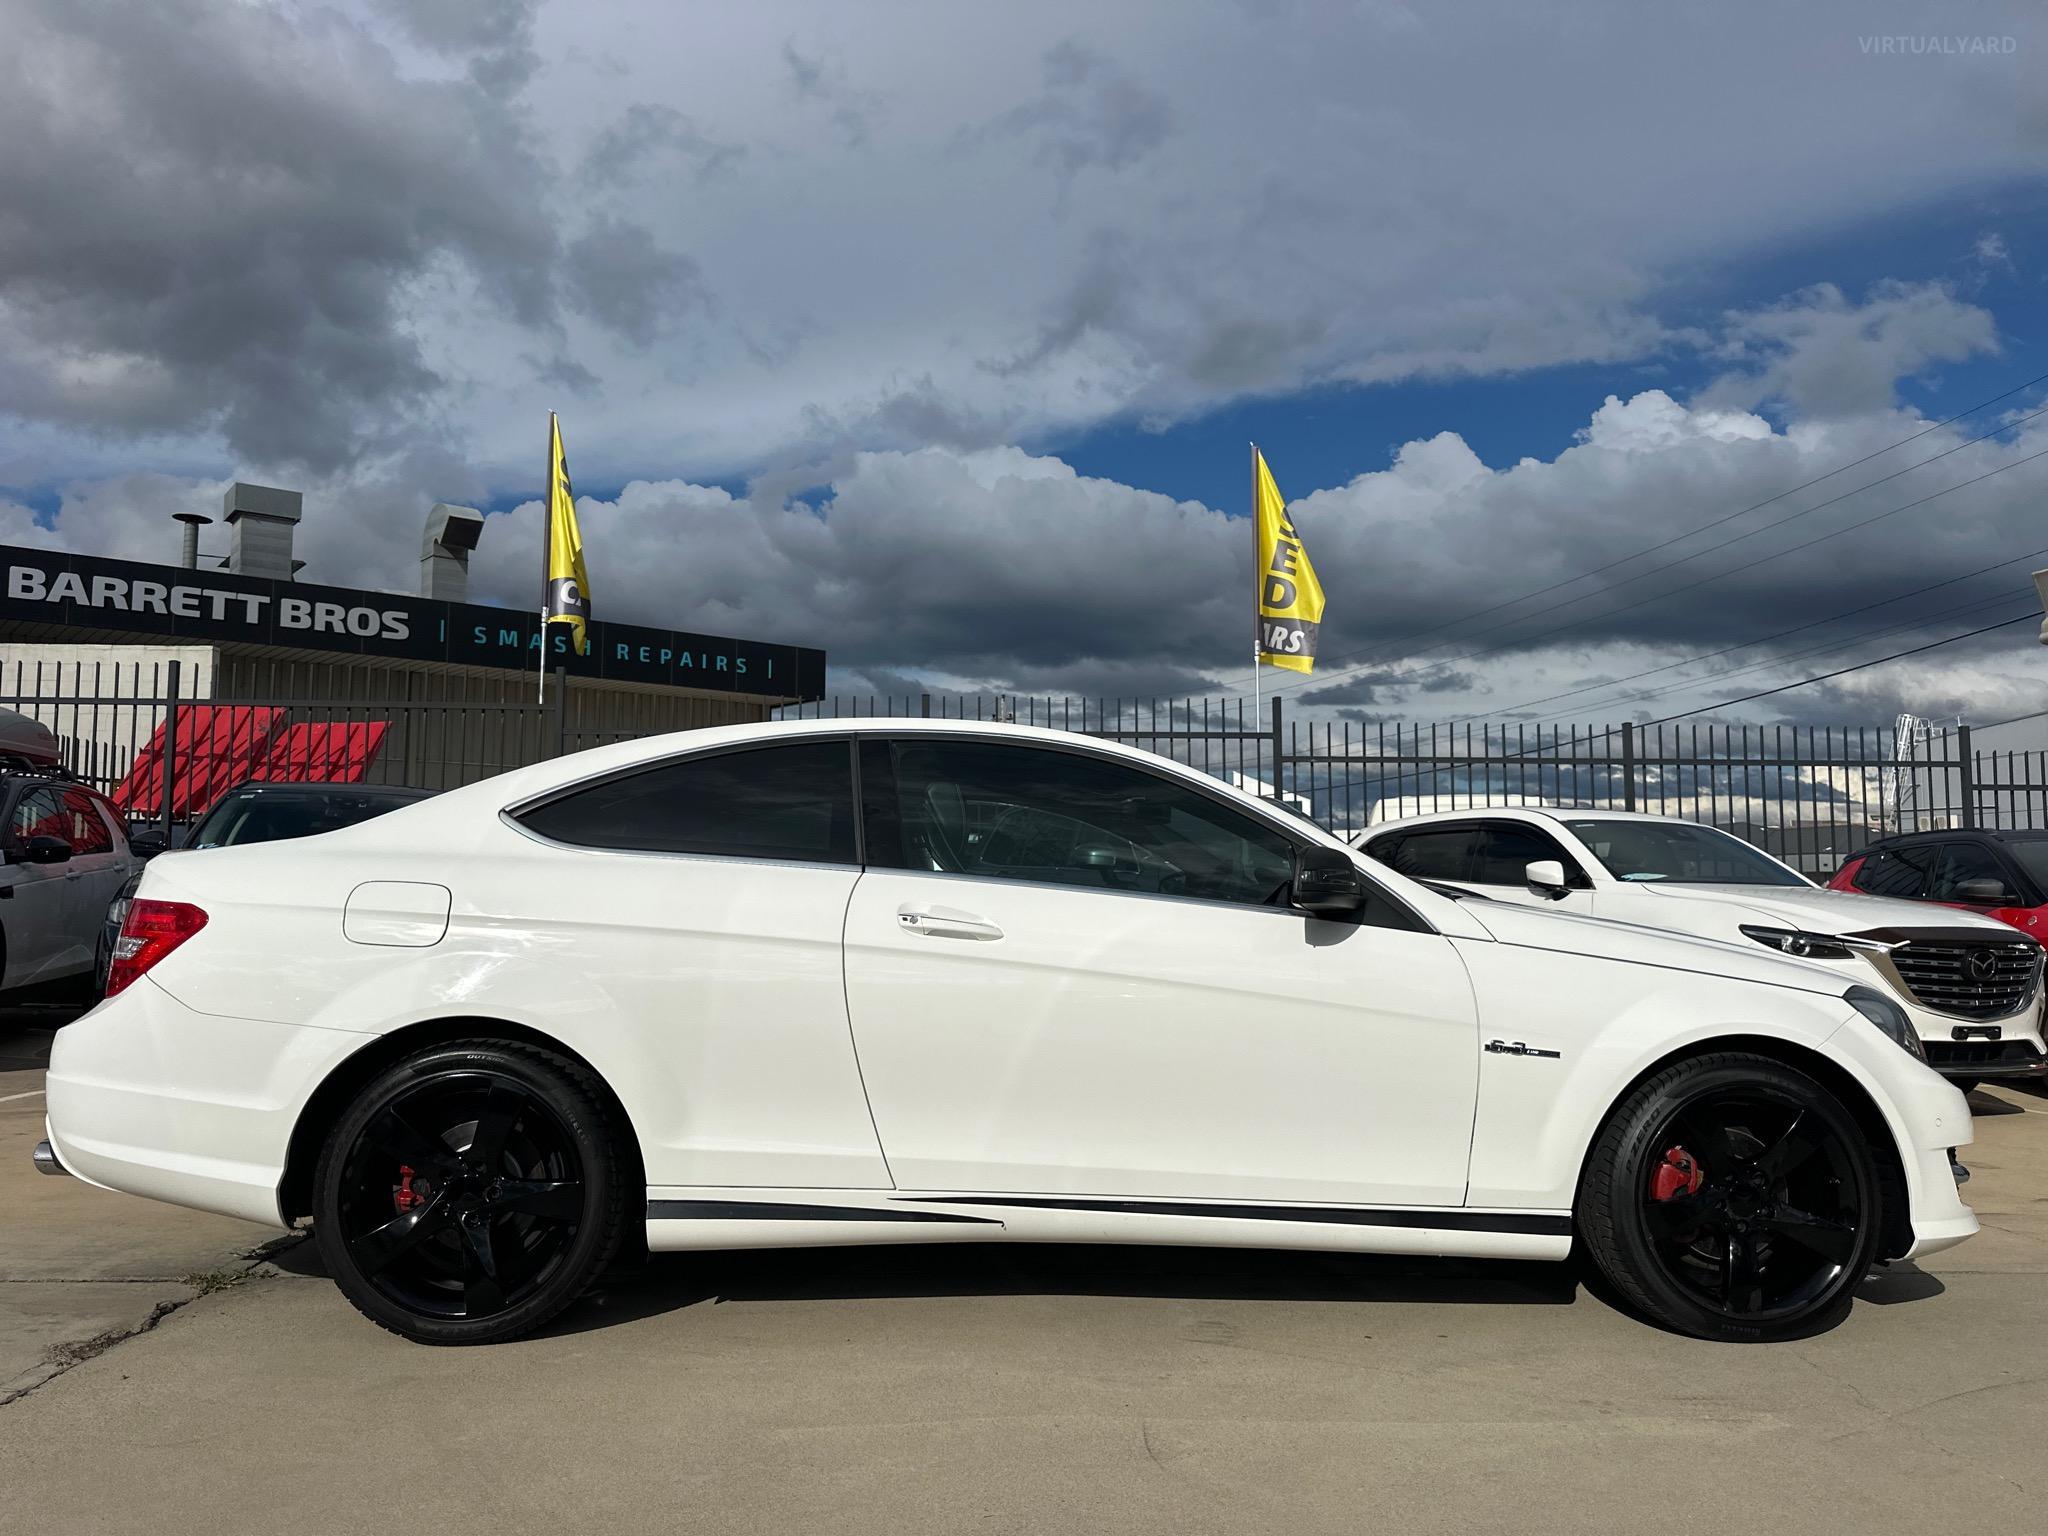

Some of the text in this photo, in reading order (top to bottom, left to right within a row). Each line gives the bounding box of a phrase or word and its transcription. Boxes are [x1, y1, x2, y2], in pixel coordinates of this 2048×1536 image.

[7, 565, 271, 625] BARRETT
[279, 597, 411, 641] BROS
[617, 643, 748, 674] REPAIRS
